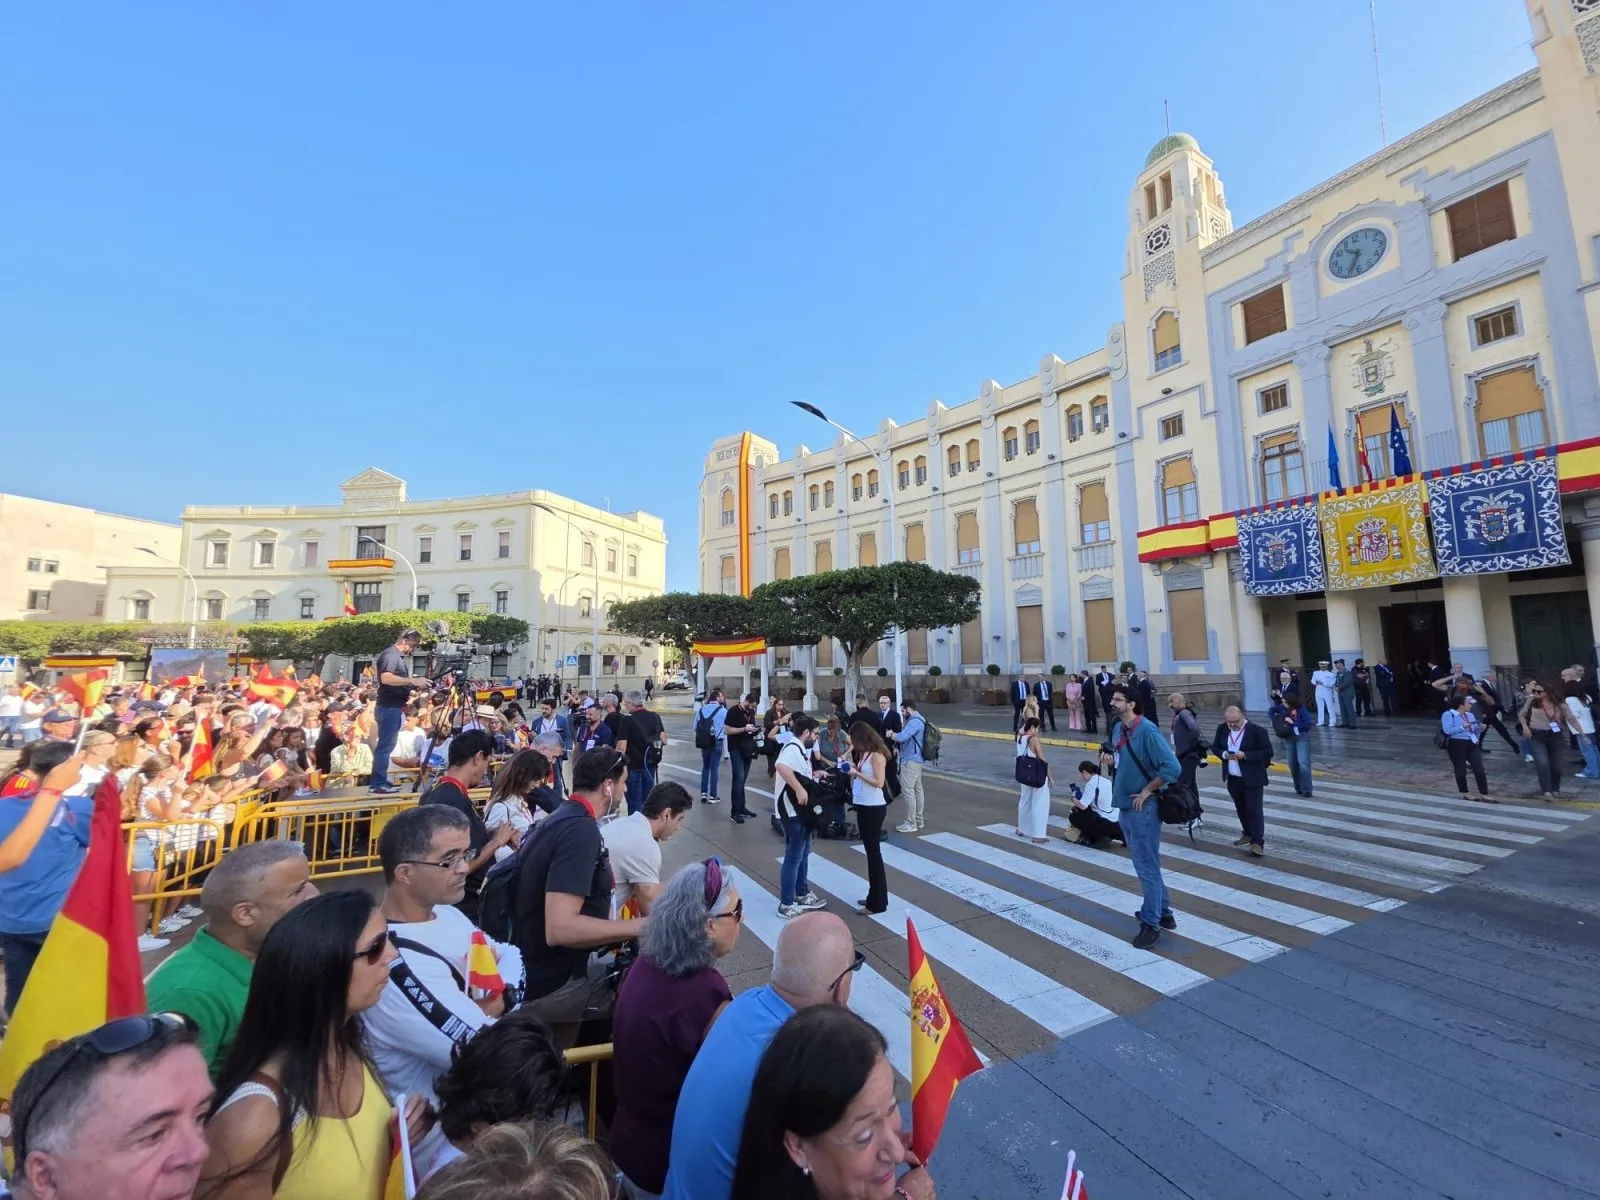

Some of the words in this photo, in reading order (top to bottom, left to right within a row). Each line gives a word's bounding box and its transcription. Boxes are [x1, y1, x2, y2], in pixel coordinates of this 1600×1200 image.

[1352, 233, 1359, 243] 12
[1372, 233, 1378, 241] 2
[1377, 240, 1383, 248] 3
[1336, 250, 1343, 258] 10
[1356, 265, 1361, 273] 6
